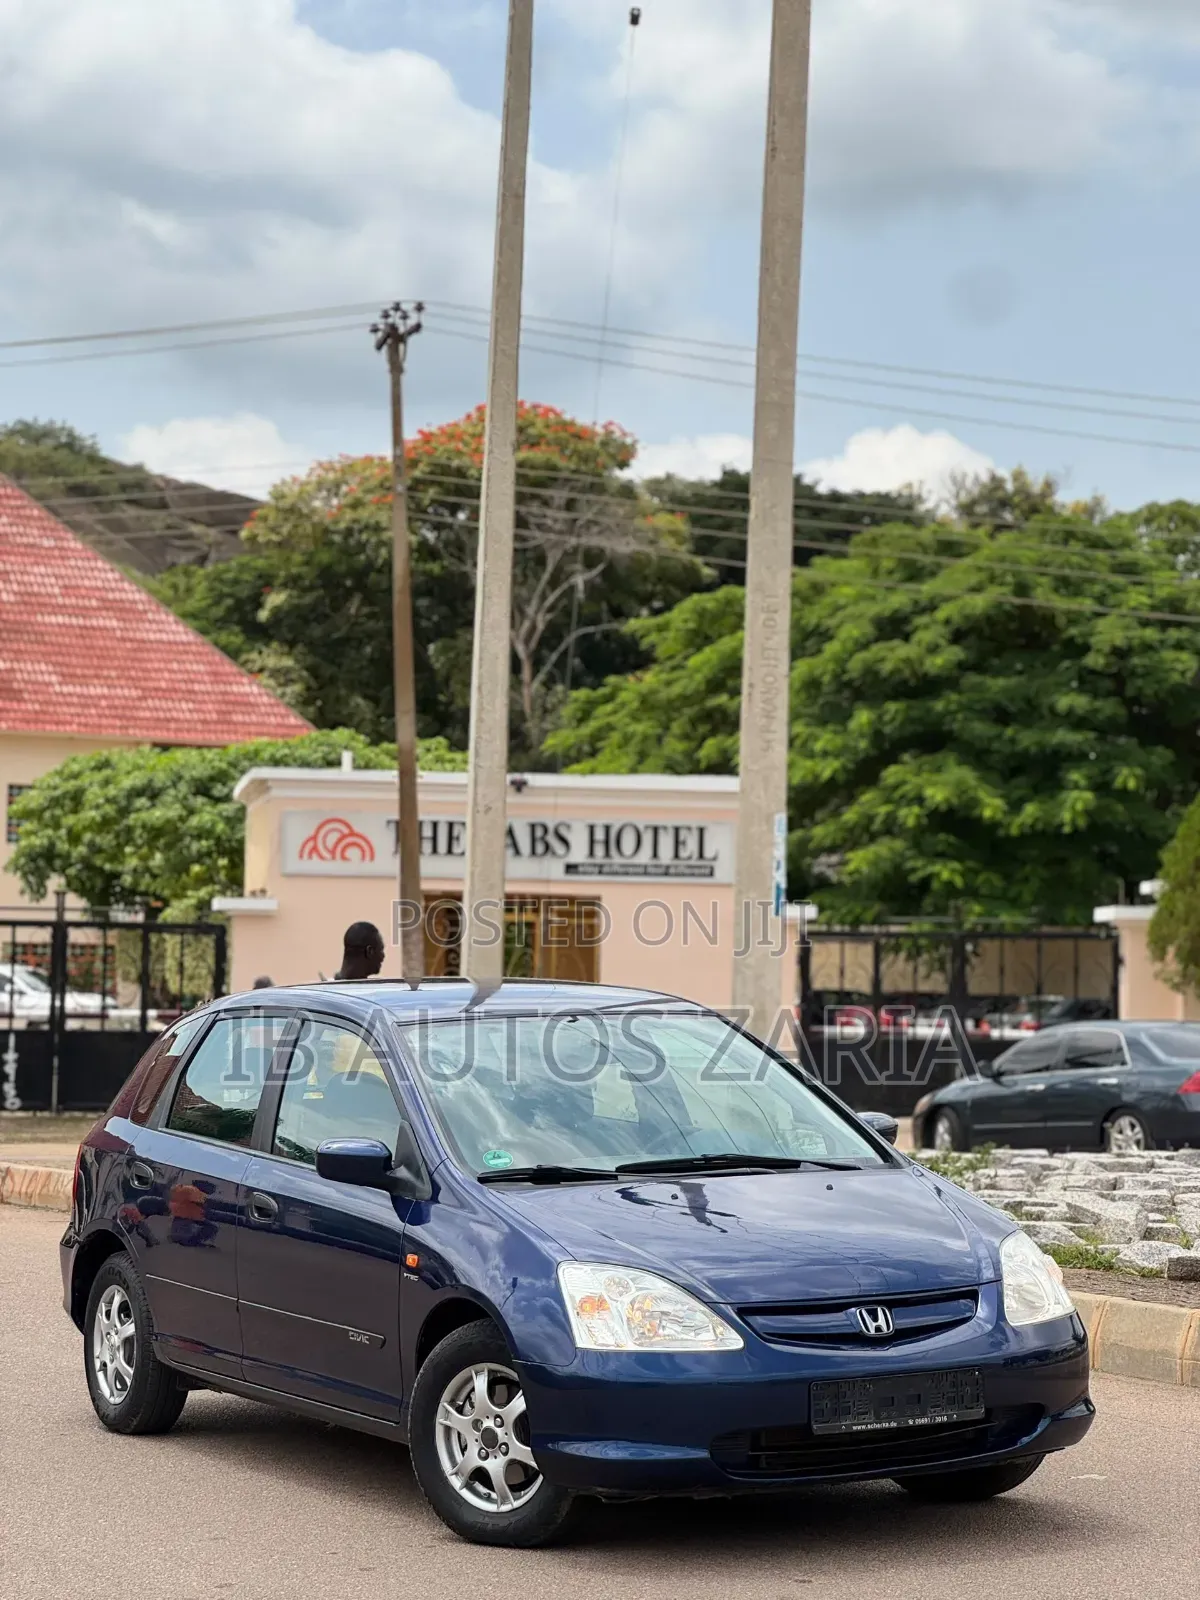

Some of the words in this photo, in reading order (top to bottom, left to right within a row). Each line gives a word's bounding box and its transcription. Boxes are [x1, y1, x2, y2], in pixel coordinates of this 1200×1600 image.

[386, 819, 466, 857] THE
[586, 822, 719, 861] HOTEL
[403, 1272, 419, 1282] VTEC
[348, 1330, 370, 1344] CIVIC
